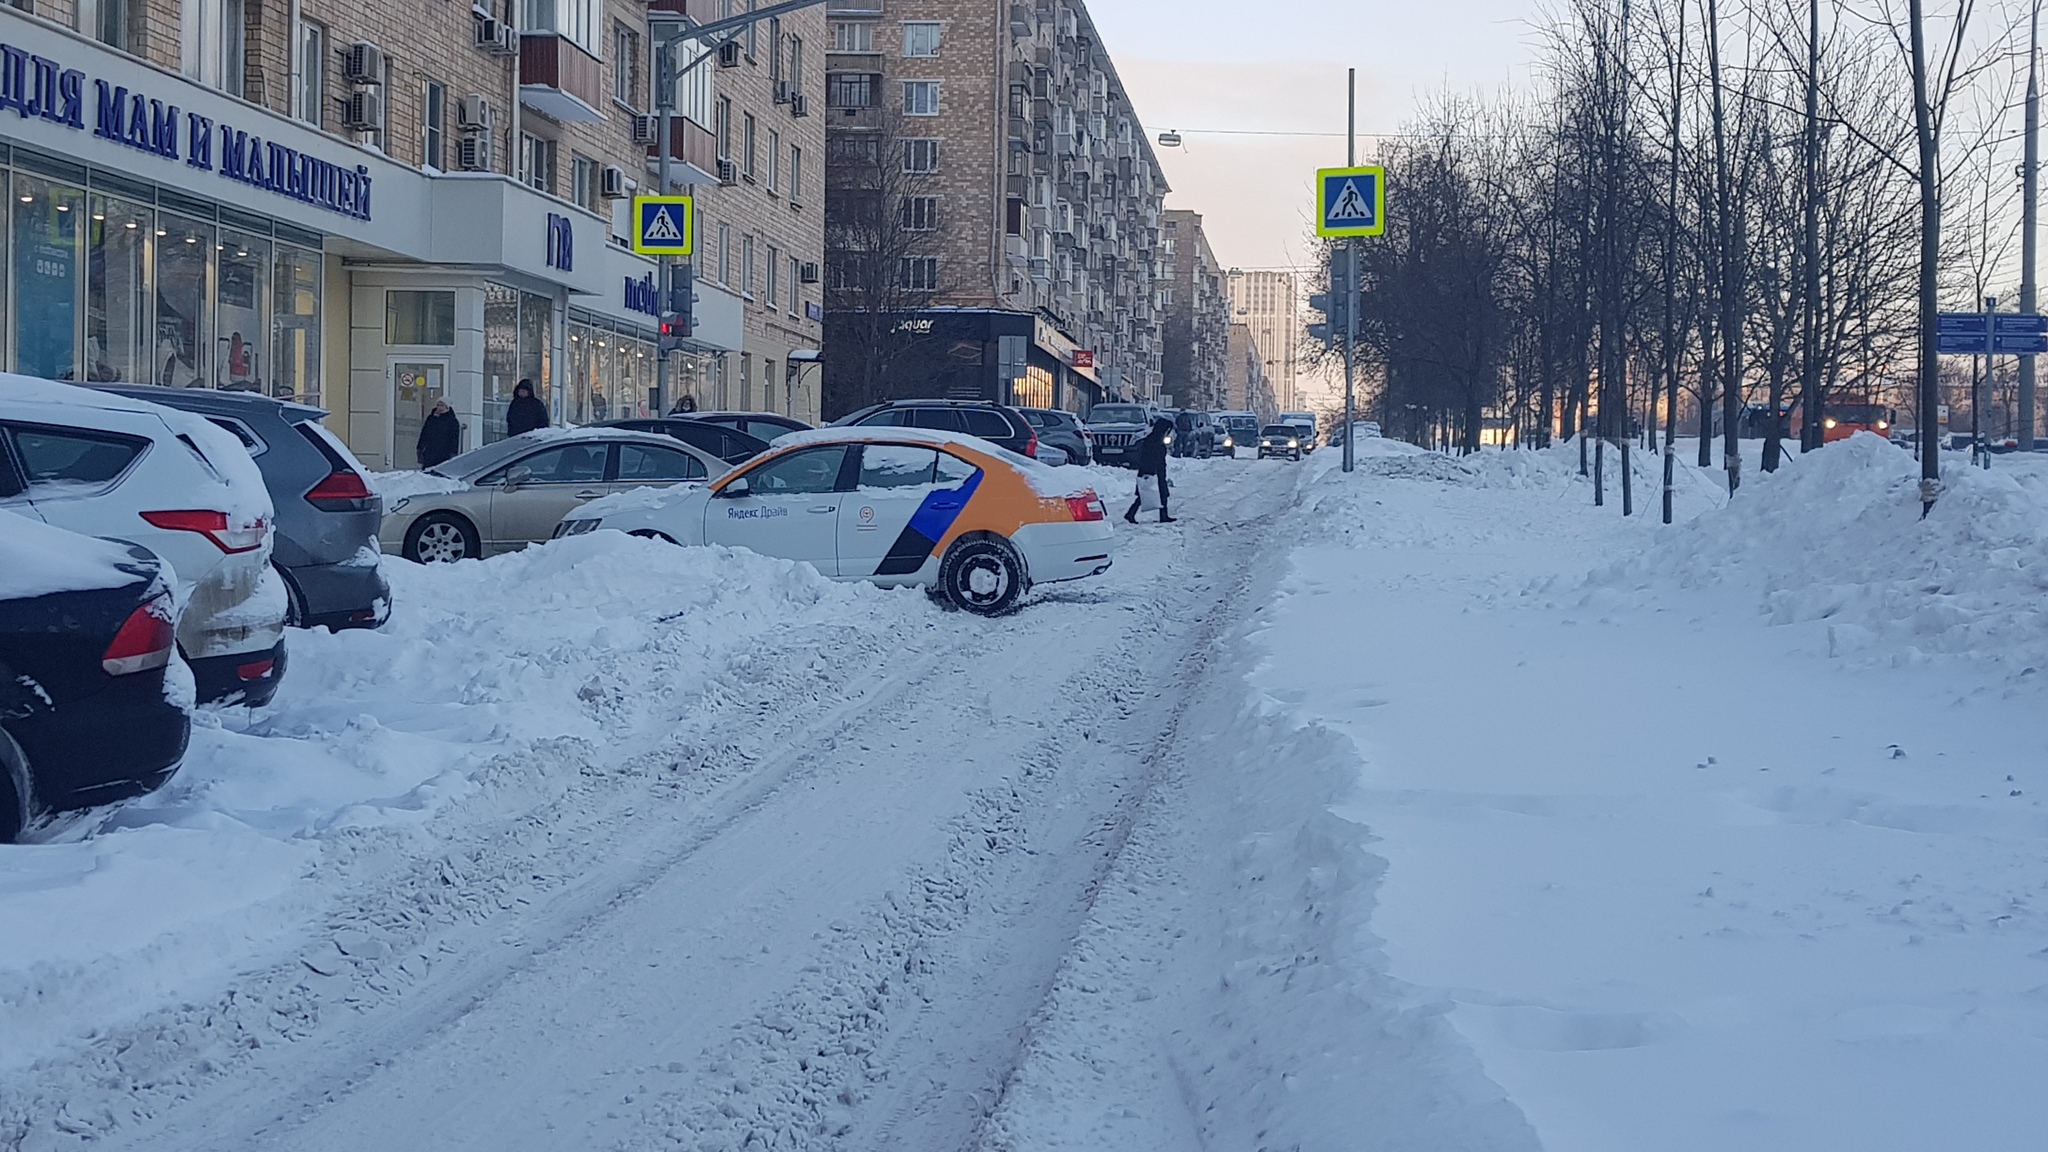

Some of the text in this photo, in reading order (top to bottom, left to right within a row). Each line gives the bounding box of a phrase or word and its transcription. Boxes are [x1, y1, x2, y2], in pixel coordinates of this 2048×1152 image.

[0, 43, 372, 222] ДЛЯ МАМ И МАЛЫШЕЙ
[727, 505, 788, 520] Яндекс Драйв
